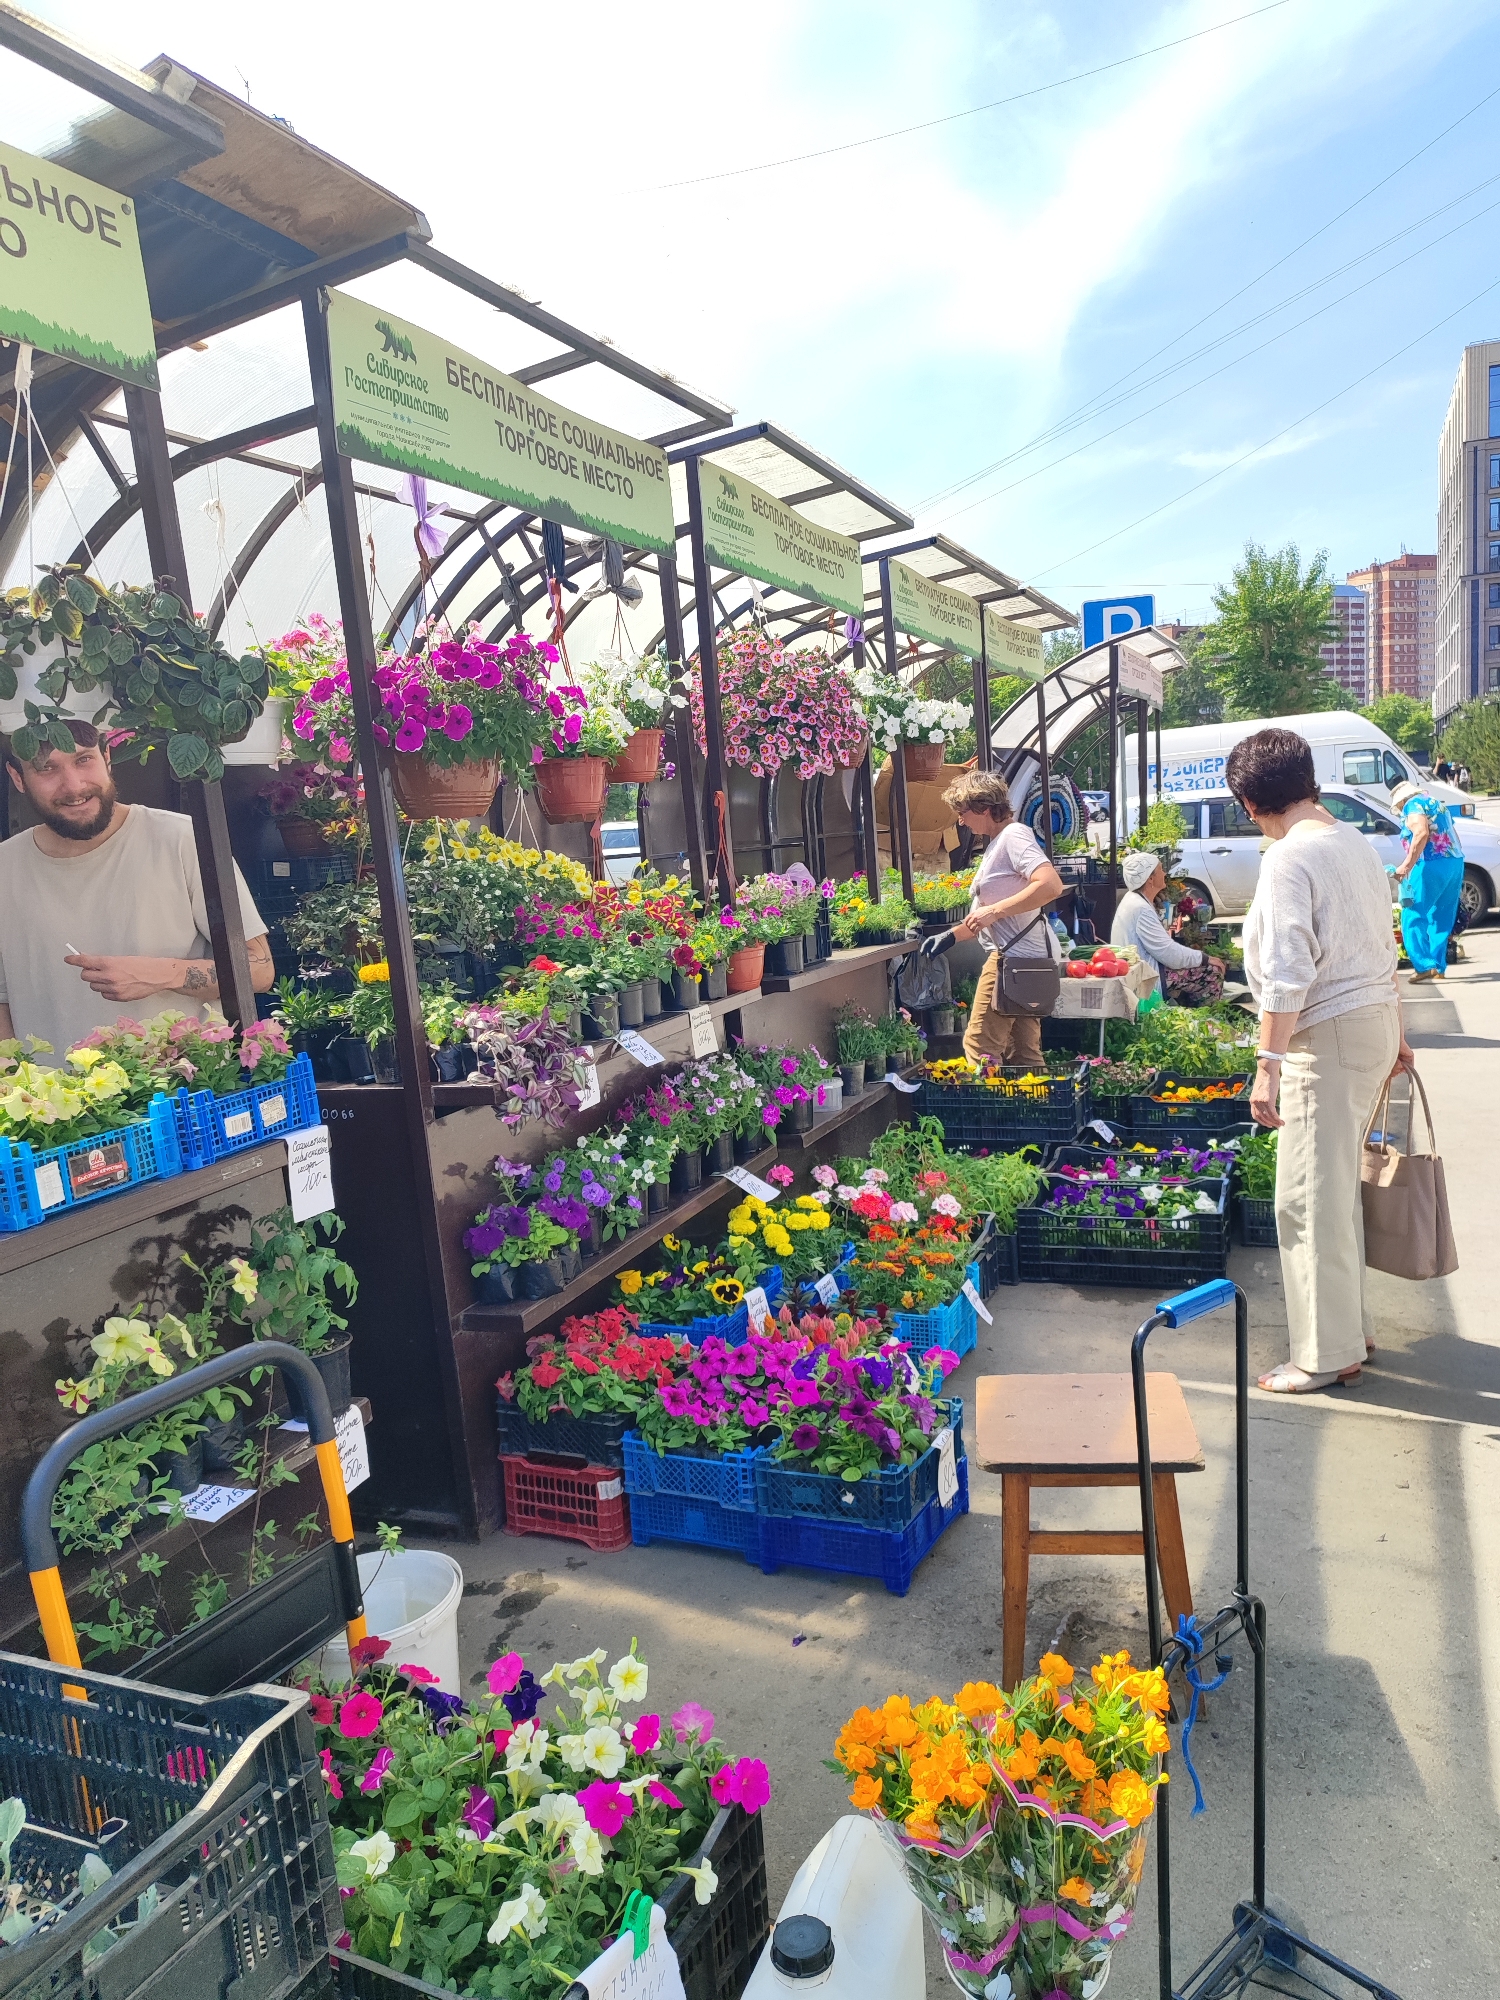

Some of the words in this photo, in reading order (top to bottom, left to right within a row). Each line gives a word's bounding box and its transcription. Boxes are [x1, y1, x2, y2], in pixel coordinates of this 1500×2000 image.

[344, 366, 449, 423] Гостеприимство
[366, 352, 429, 394] Сибирское
[445, 357, 559, 438] БЕСПЛАТНОЕ
[562, 421, 665, 482] СОЦИАЛЬНОЕ
[495, 420, 580, 487] ТОРГОВОЕ
[583, 461, 634, 499] МЕСТО
[751, 494, 804, 541] БЕСПЛАТНОЕ
[804, 528, 859, 565] СОЦИАЛЬНОЕ
[774, 532, 816, 568] ТОРГОВОЕ
[815, 555, 845, 579] МЕСТО
[321, 1108, 355, 1120] 0066
[596, 1942, 658, 2000] ЕТУНИЯ
